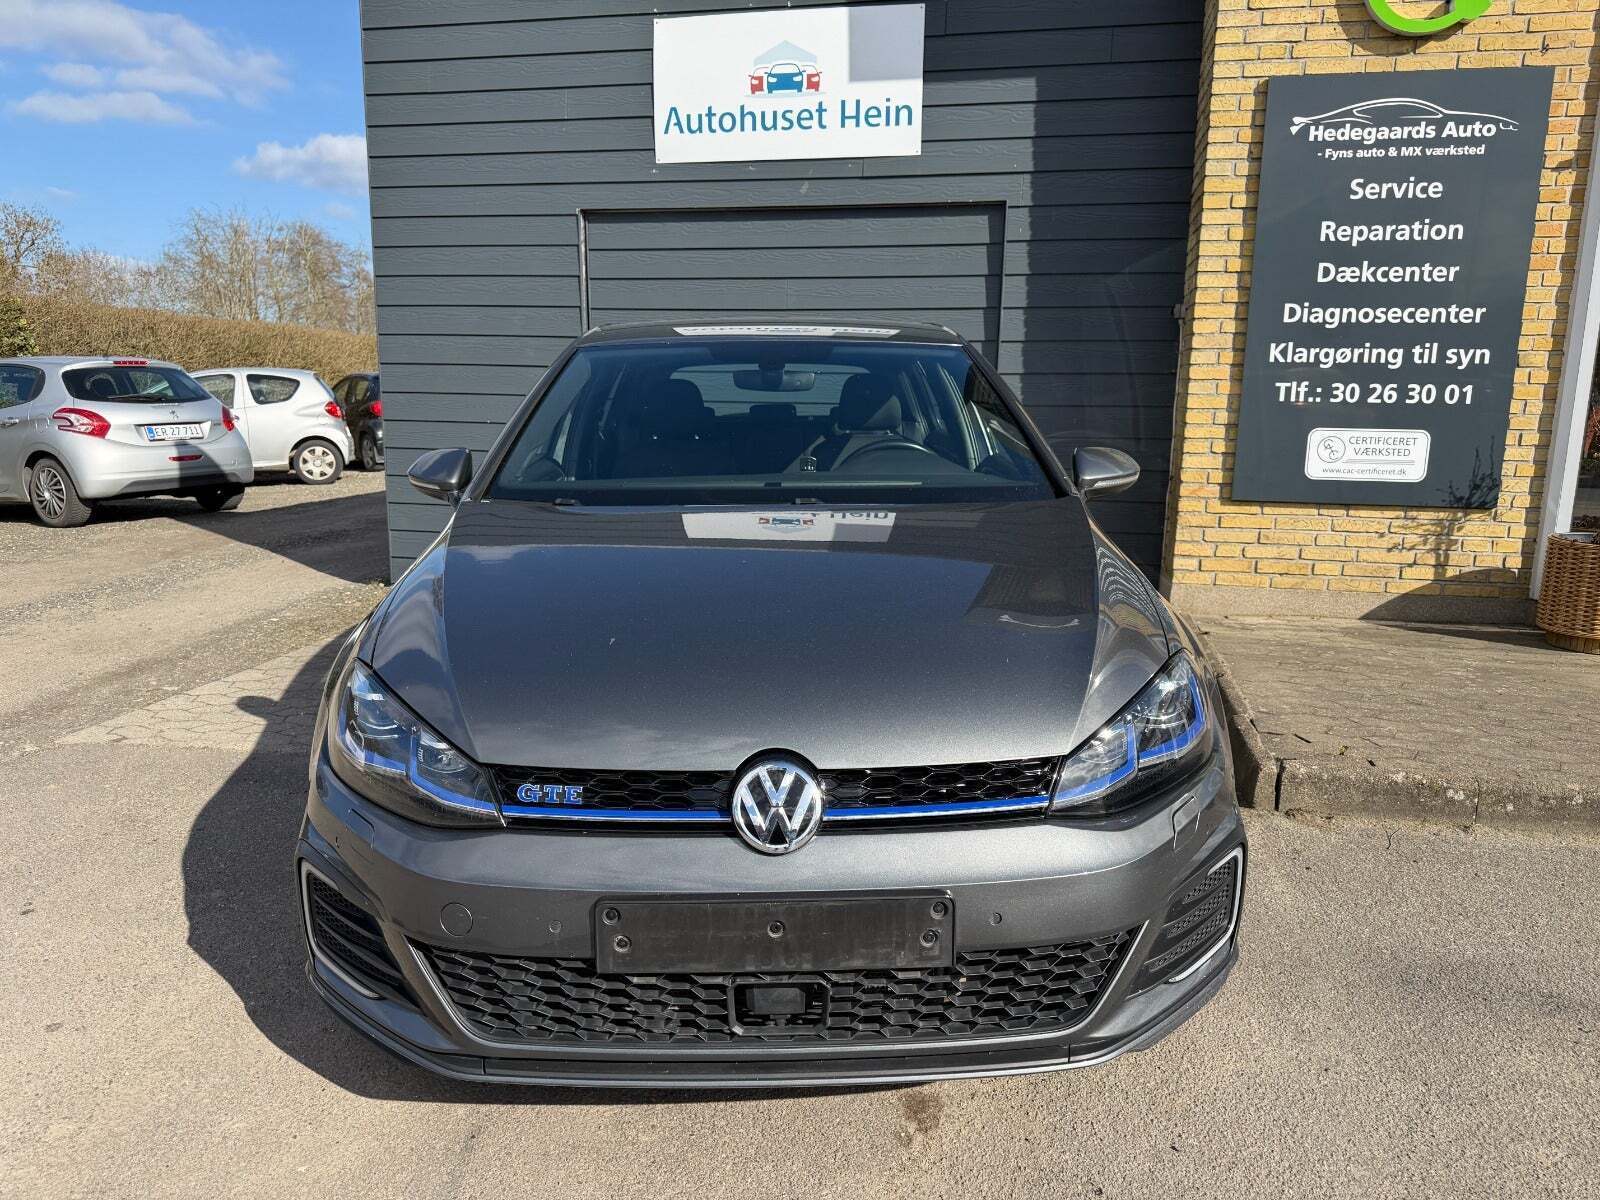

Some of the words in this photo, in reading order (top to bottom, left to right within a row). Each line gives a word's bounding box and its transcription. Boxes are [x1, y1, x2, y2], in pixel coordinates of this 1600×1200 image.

[664, 101, 827, 135] Autohuset
[840, 98, 913, 128] Hein
[1308, 121, 1436, 144] Hedegaards
[1441, 121, 1497, 138] Auto
[1325, 149, 1353, 160] Fyns
[1356, 147, 1385, 158] auto
[1388, 147, 1398, 157] &
[1400, 147, 1423, 156] MX
[1425, 144, 1486, 156] værksted
[1350, 176, 1444, 200] Service
[1320, 218, 1464, 246] Reparation
[1316, 261, 1460, 283] Dækcenter
[1282, 302, 1487, 328] Diagnosecenter
[1268, 342, 1404, 369] Klargøring
[1412, 342, 1438, 364] til
[1446, 347, 1491, 369] syn
[1275, 382, 1322, 402] Tlf.:
[1329, 383, 1360, 404] 30
[1367, 383, 1398, 404] 26
[1405, 383, 1437, 404] 30
[1444, 384, 1474, 405] 01
[1348, 436, 1418, 446] CERTIFICERET
[1353, 447, 1411, 457] VÆRKSTED
[1322, 467, 1407, 476] www.cac-certificeret.dk
[517, 783, 583, 805] GTE
